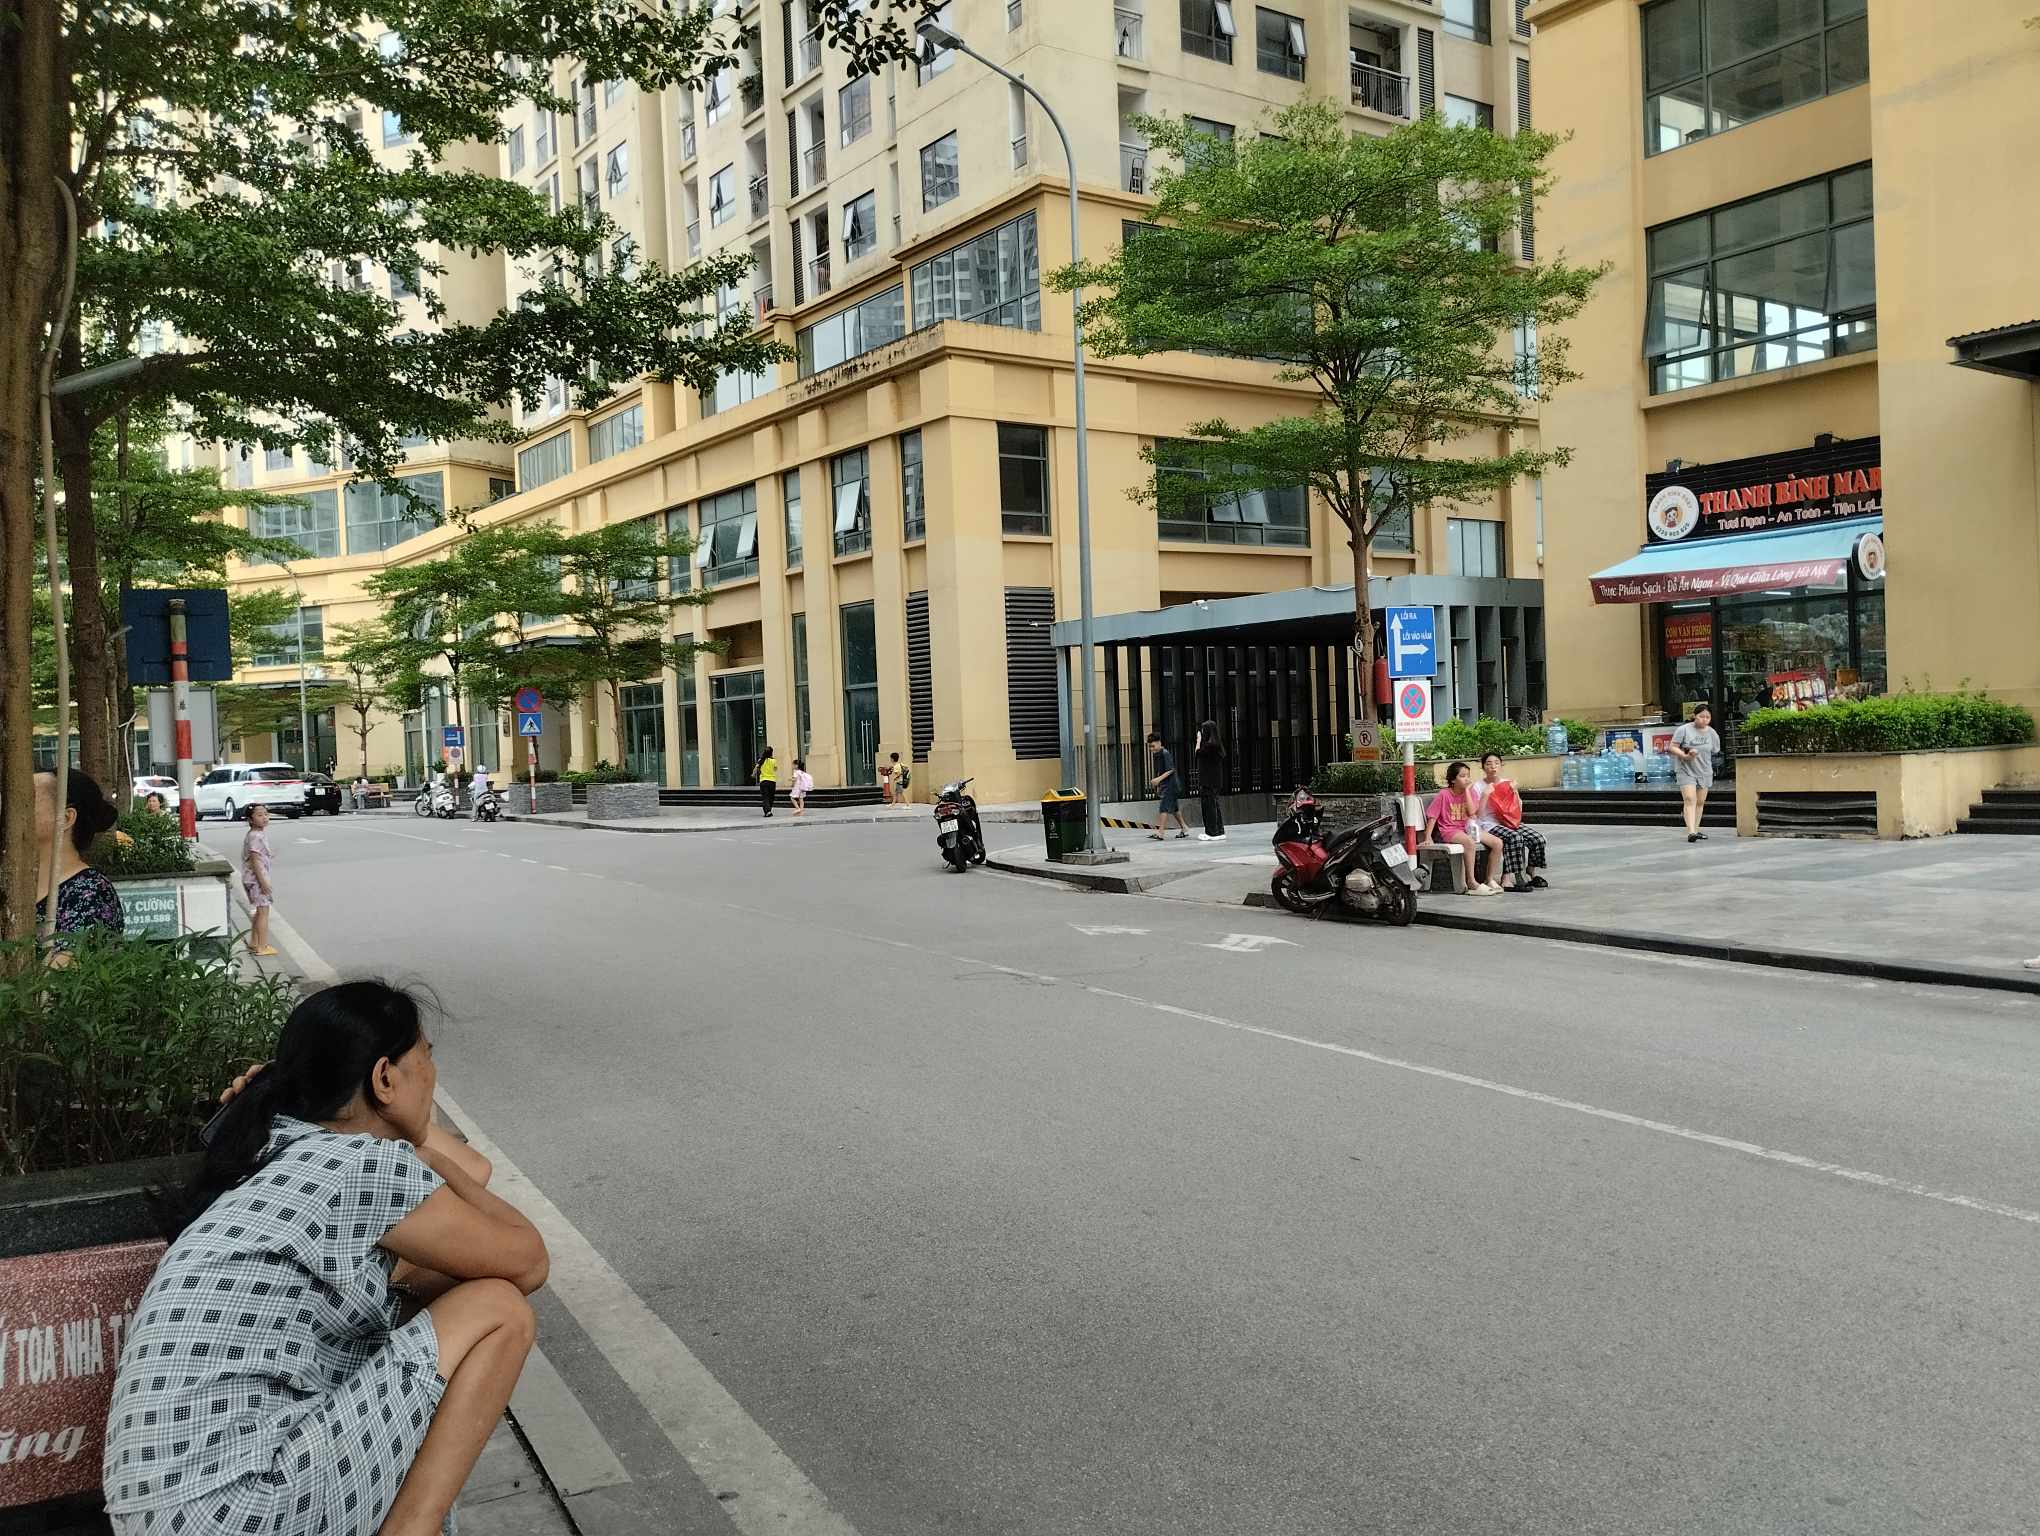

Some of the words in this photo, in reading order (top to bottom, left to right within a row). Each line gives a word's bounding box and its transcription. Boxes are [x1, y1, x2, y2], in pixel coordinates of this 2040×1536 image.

[1700, 484, 1772, 515] THANH
[1775, 473, 1830, 504] BÌNH
[1777, 512, 1793, 523] An
[1643, 582, 1661, 596] Sạch
[1691, 577, 1714, 592] Ngon
[63, 1302, 104, 1377] NHÀ
